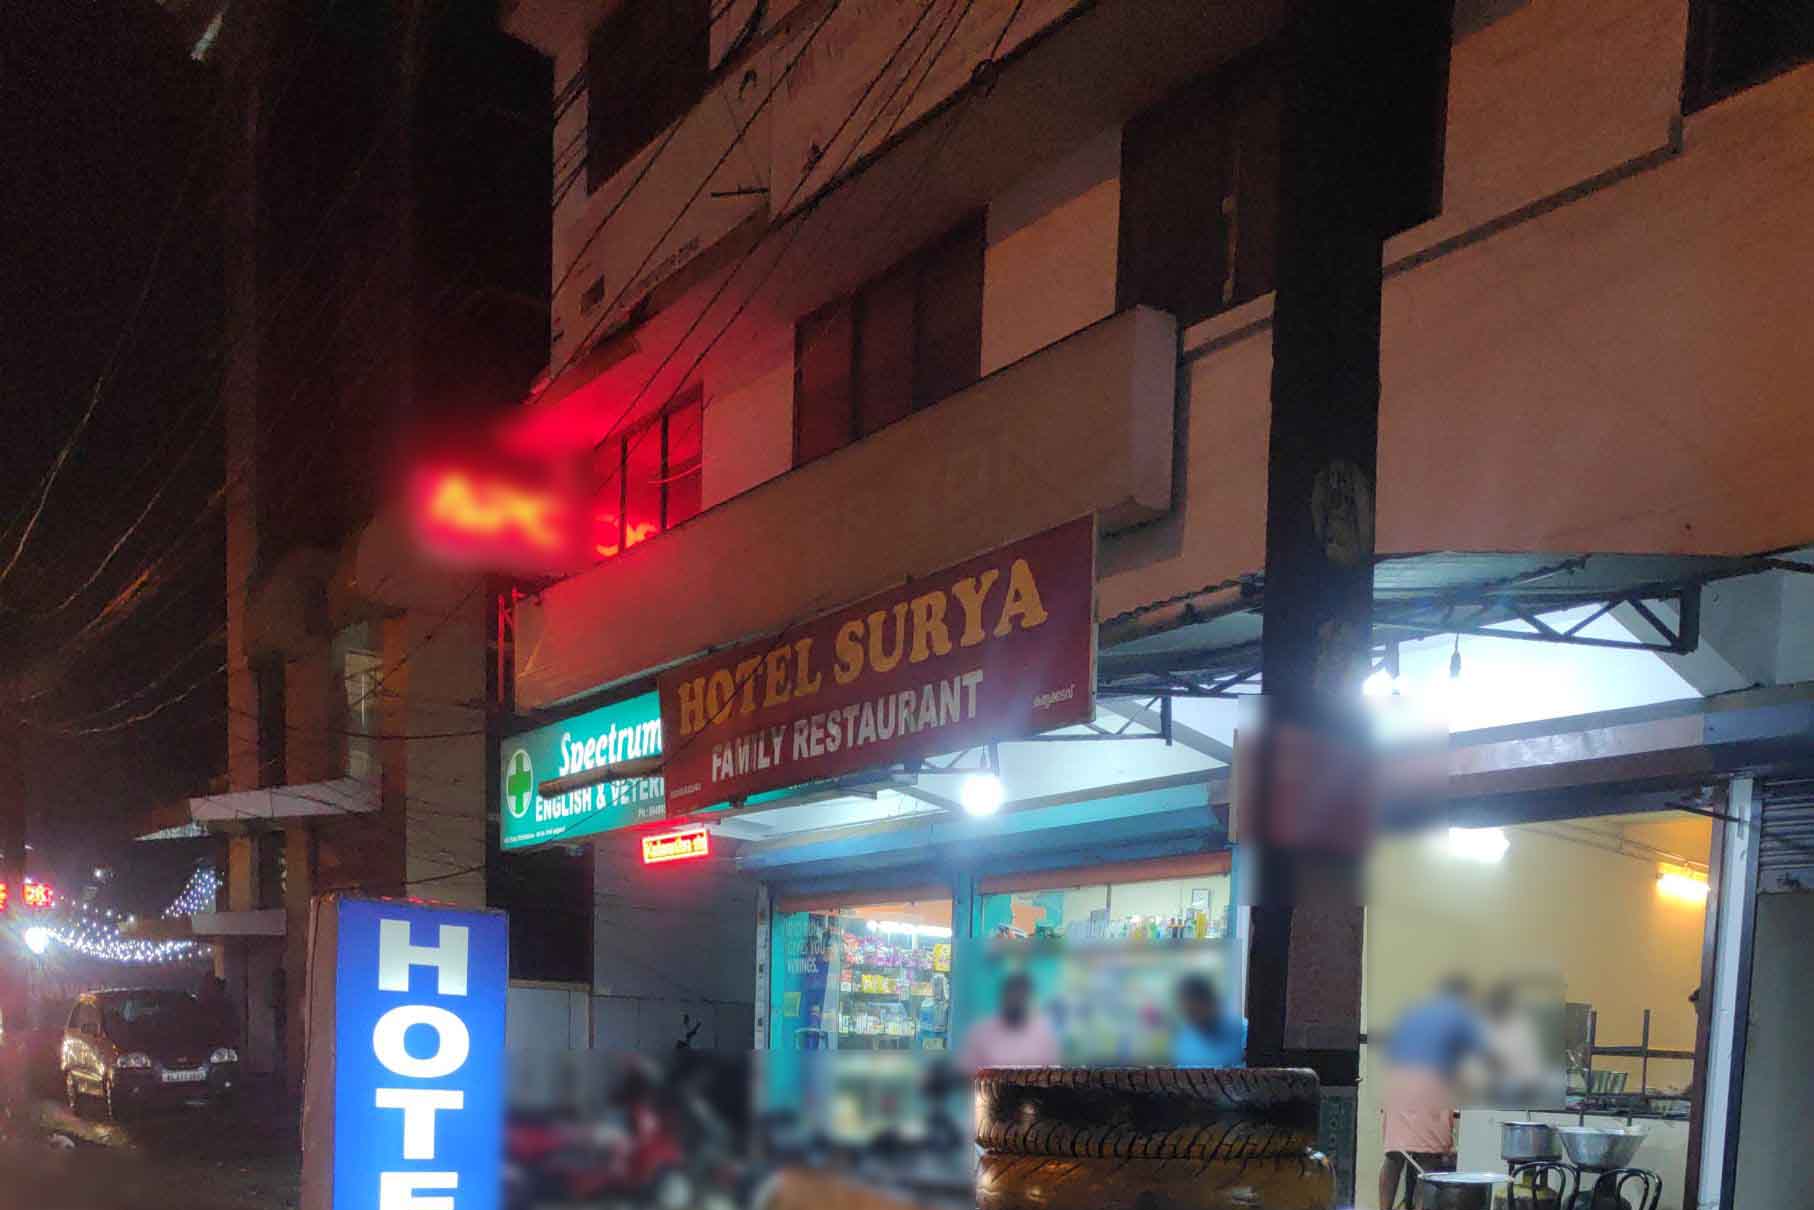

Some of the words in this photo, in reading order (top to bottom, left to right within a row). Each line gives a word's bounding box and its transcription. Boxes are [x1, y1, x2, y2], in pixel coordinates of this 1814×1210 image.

[678, 638, 821, 736] HOTEL
[833, 558, 1048, 686] SURYA
[559, 718, 662, 777] Spectrum
[711, 724, 785, 783] FAMILY
[793, 669, 984, 762] RESTAURANT
[536, 783, 593, 822] ENGLISH
